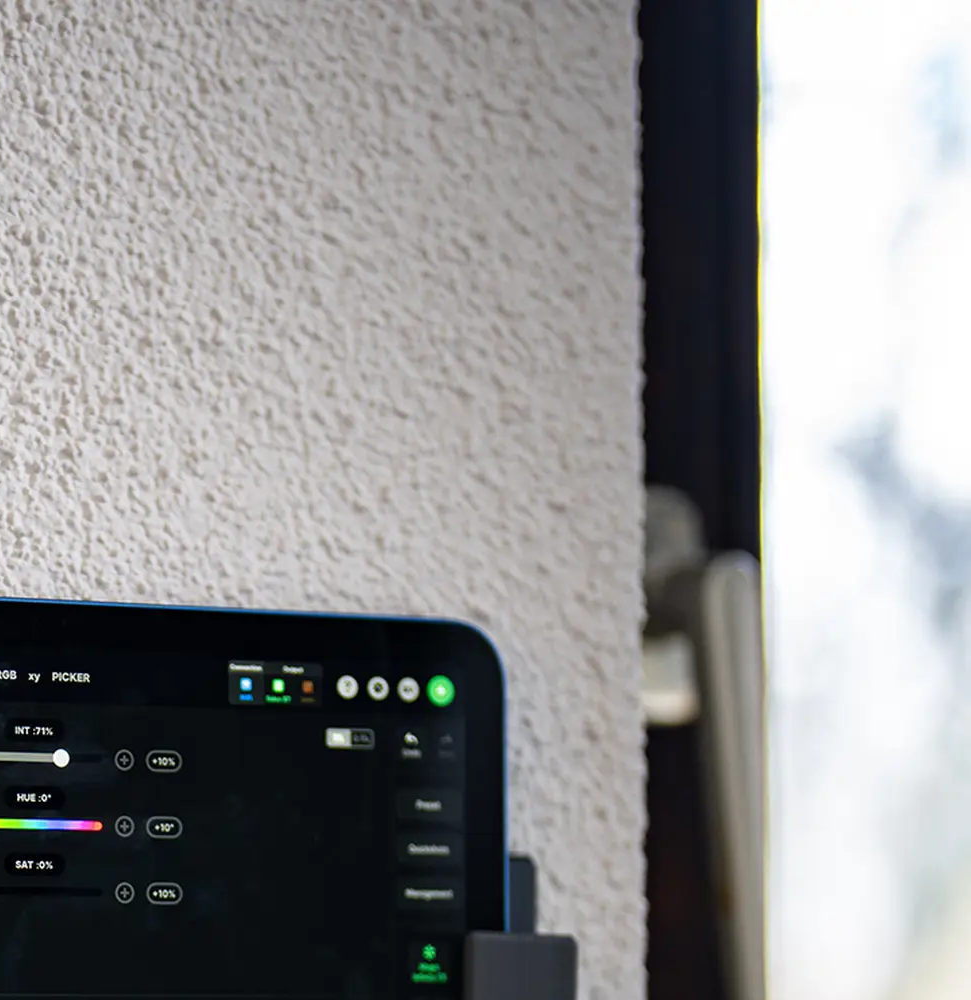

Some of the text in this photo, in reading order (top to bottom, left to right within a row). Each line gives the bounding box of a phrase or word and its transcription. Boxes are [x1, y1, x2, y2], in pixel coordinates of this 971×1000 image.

[28, 672, 40, 683] xy
[51, 672, 91, 683] PICKER
[14, 726, 53, 736] INT :71%
[152, 757, 175, 767] +10%
[16, 793, 36, 802] HUE
[15, 860, 53, 870] SAT :0%
[152, 889, 176, 899] +10%
